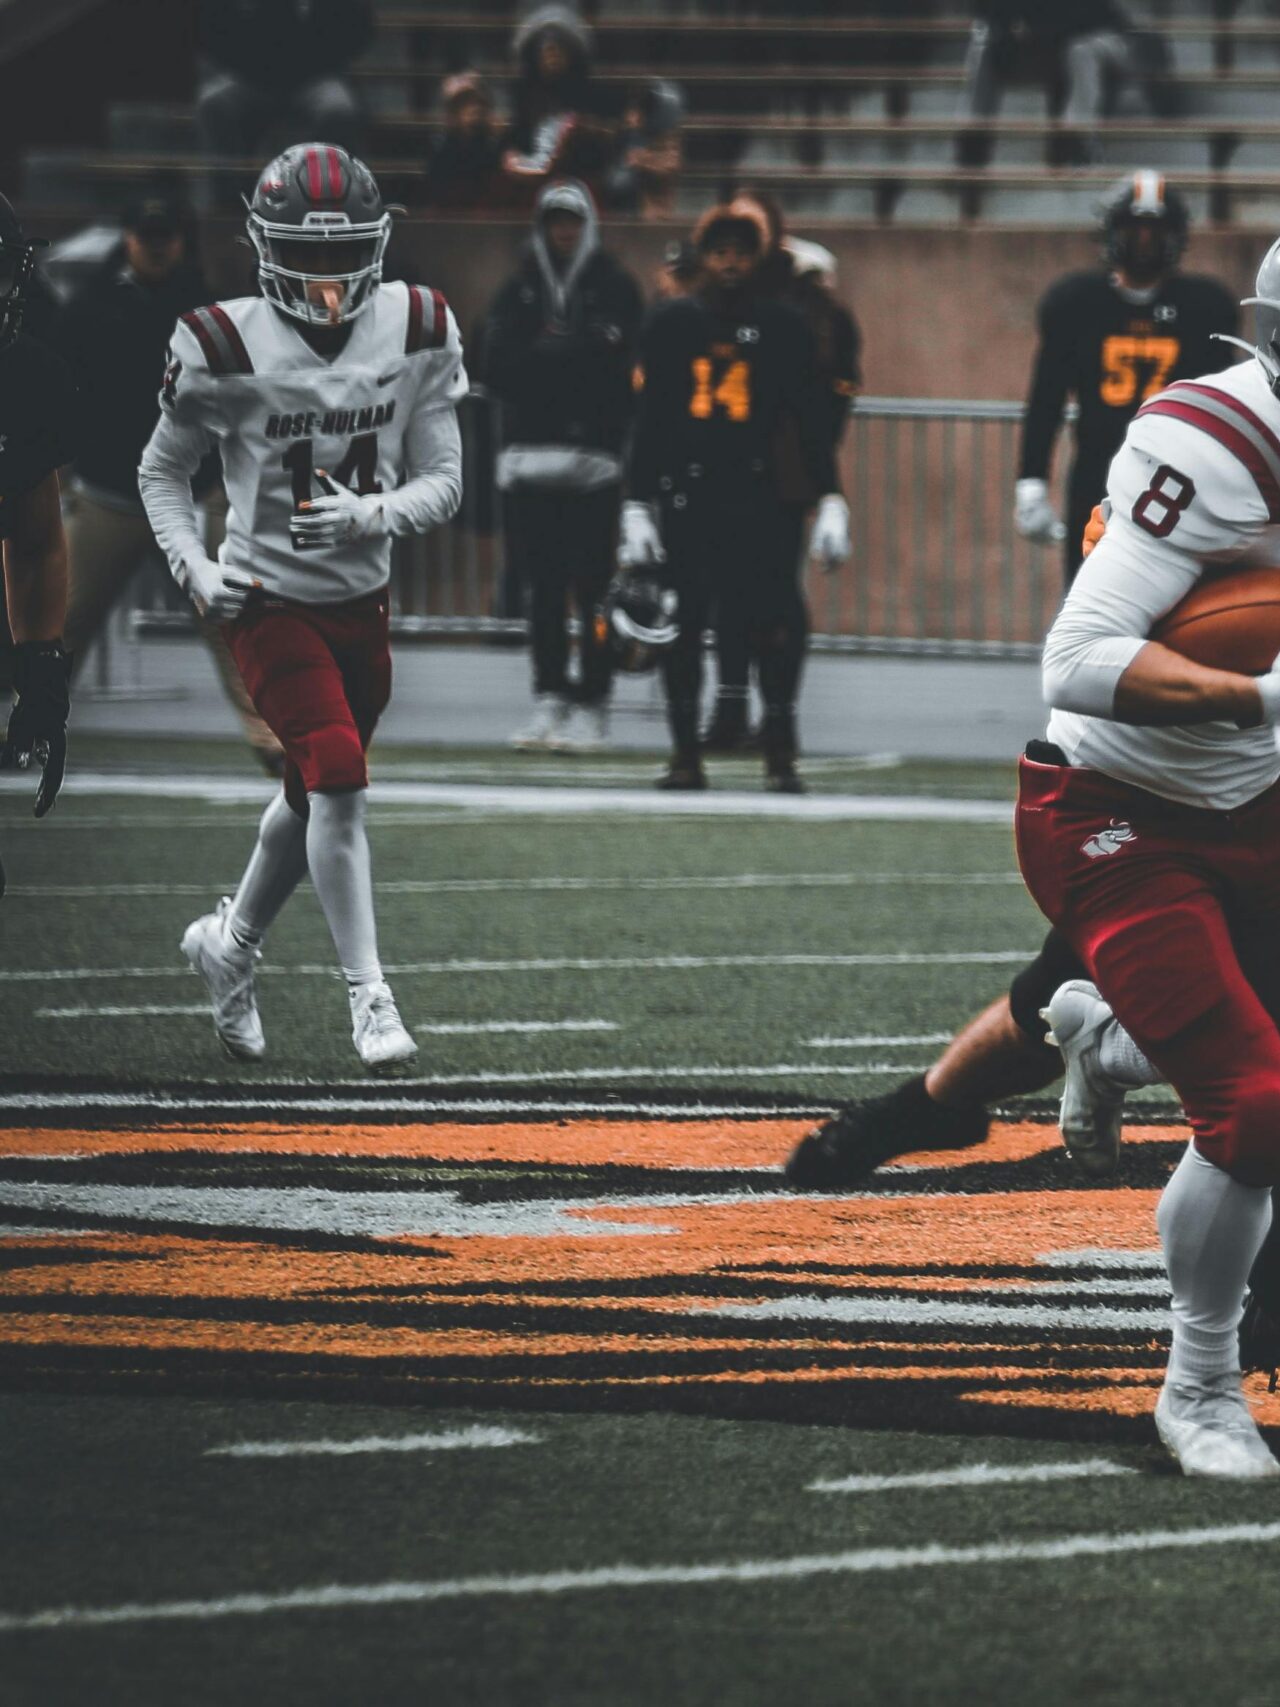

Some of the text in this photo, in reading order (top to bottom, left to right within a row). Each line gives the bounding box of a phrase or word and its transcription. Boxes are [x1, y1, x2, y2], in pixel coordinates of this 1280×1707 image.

[689, 357, 750, 423] 14
[1100, 334, 1181, 408] 57
[265, 400, 396, 439] ROSE-HULMAN
[277, 432, 383, 553] 14
[1131, 464, 1196, 538] 8
